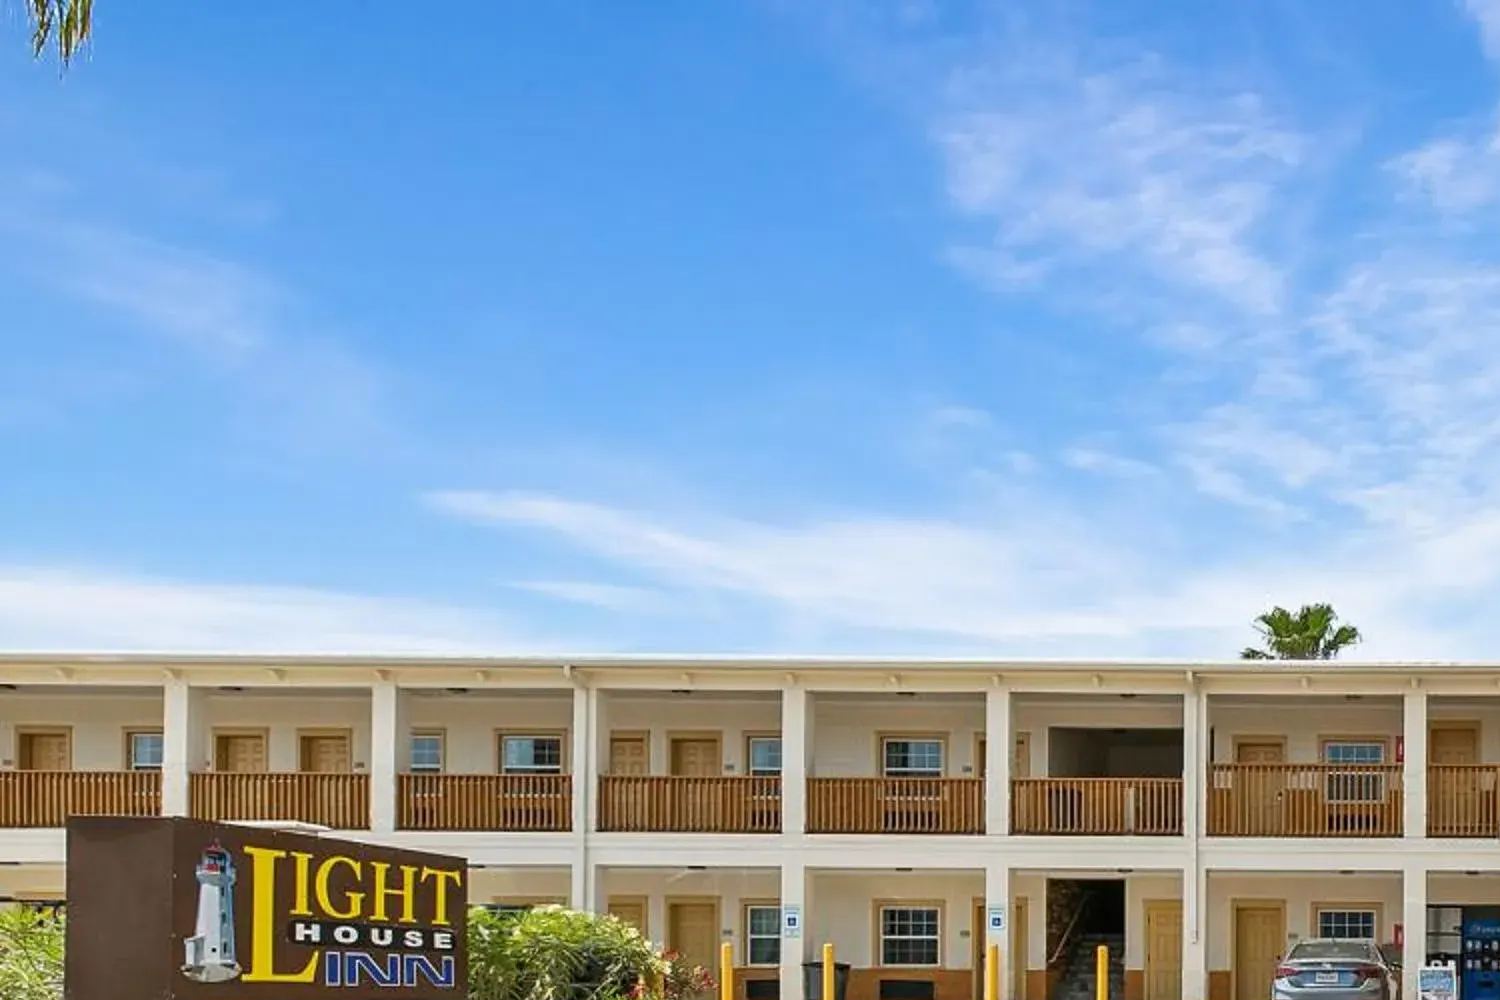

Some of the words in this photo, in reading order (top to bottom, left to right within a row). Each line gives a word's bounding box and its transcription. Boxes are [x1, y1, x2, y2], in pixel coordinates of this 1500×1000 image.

[241, 845, 461, 983] LIGHT
[295, 922, 453, 949] HOUSE
[325, 951, 455, 987] INN
